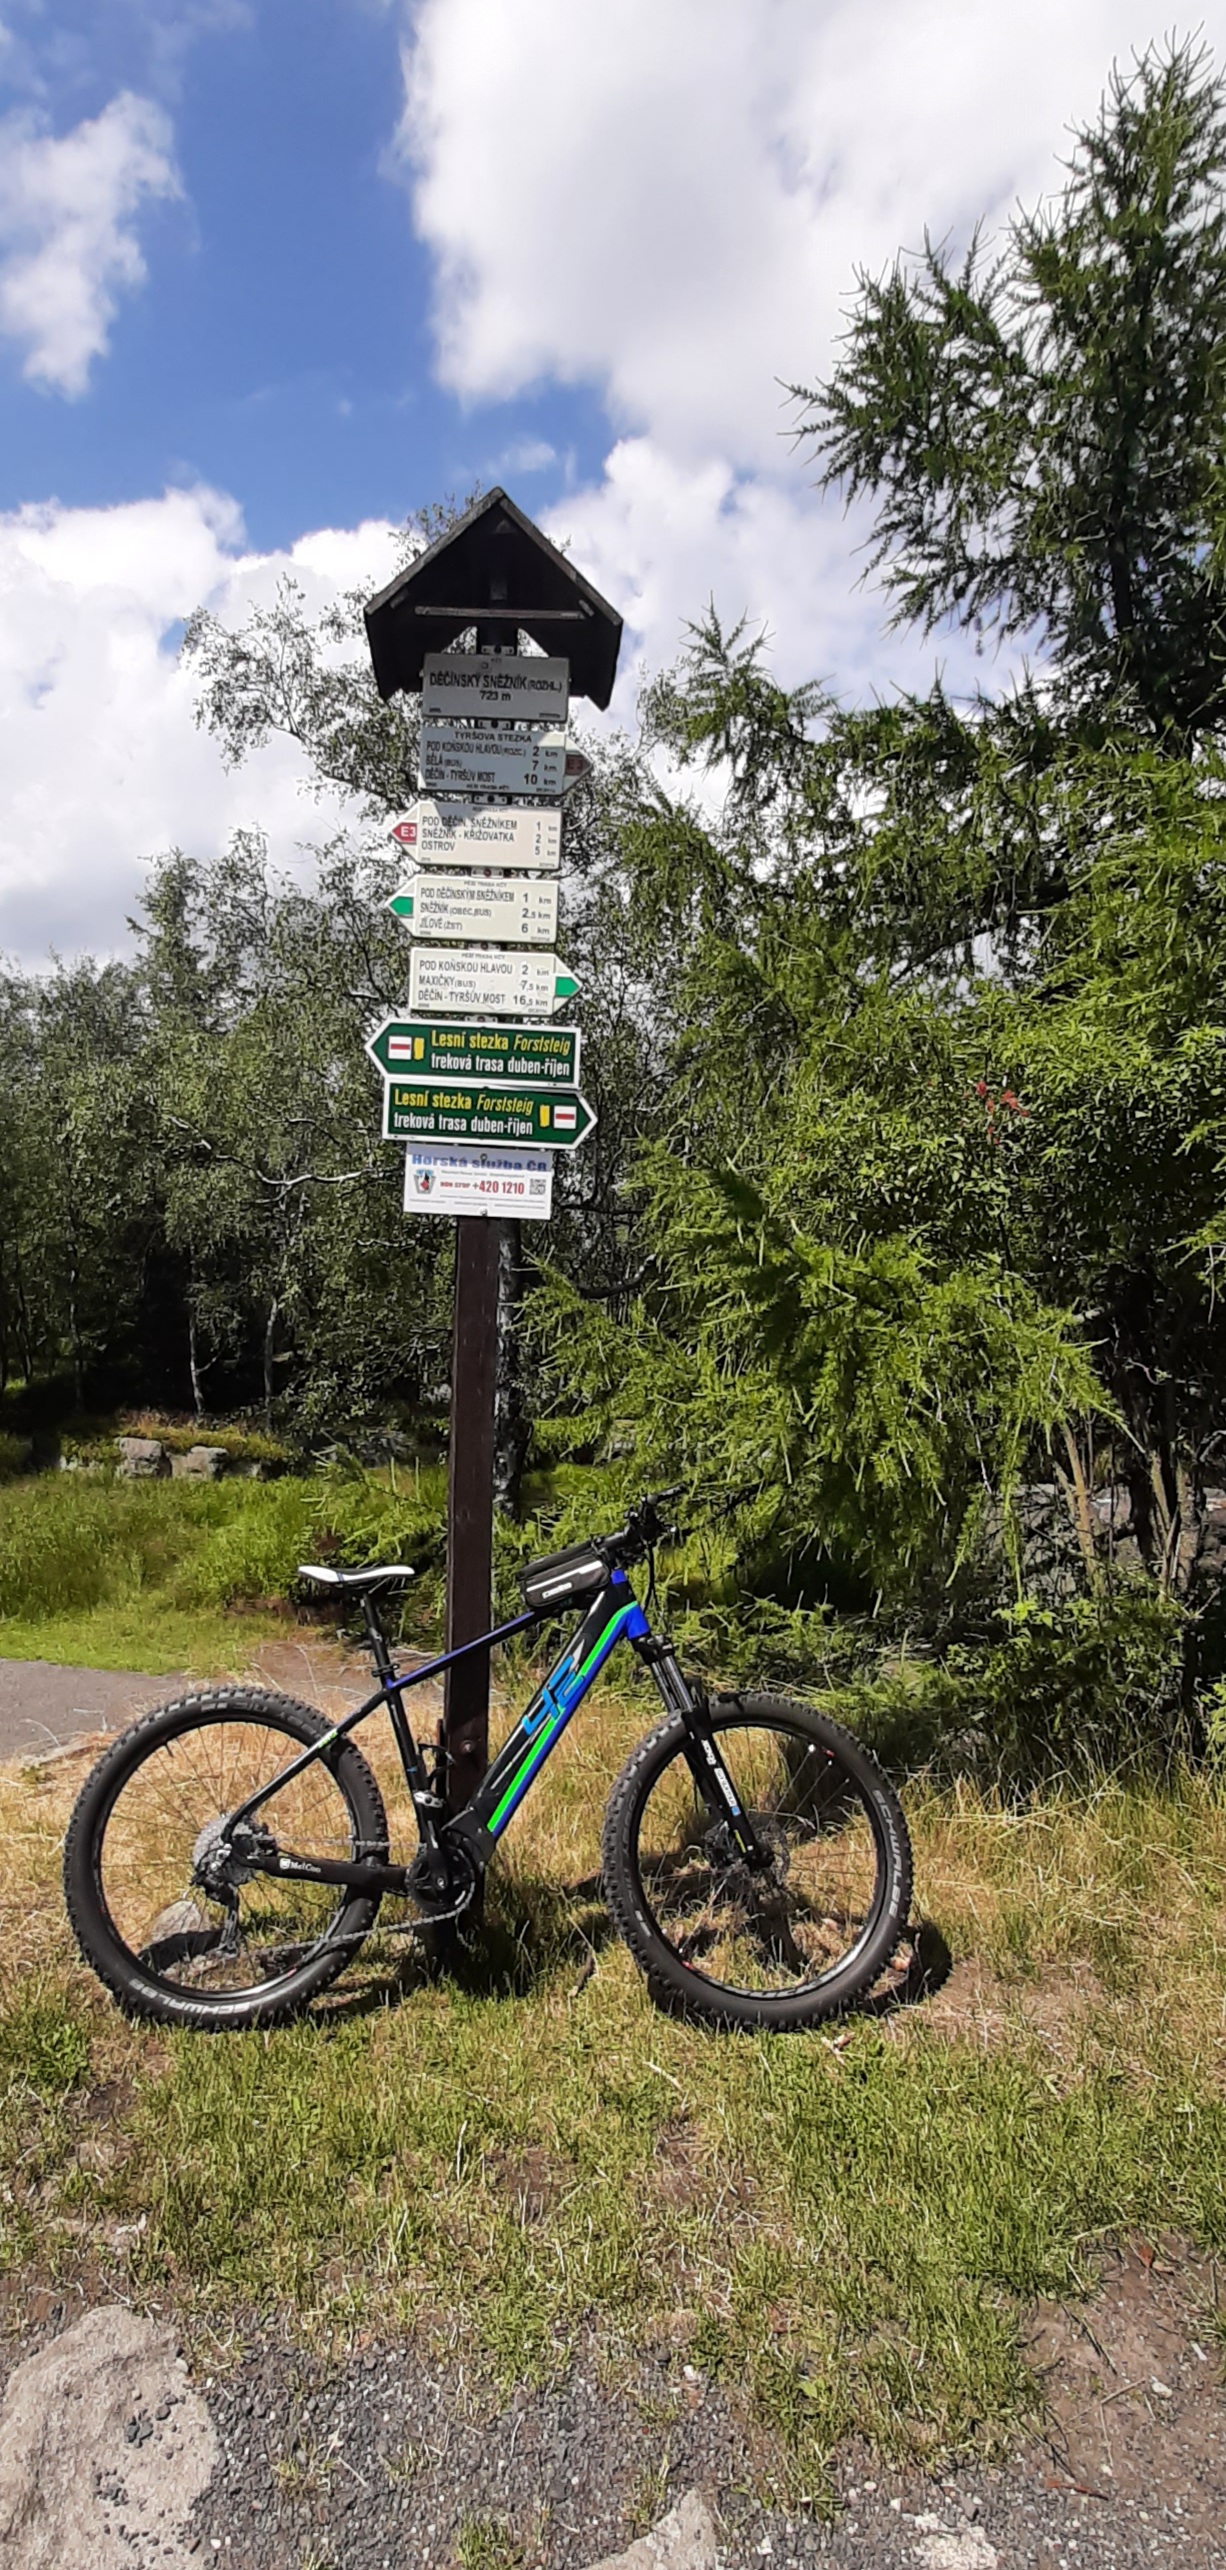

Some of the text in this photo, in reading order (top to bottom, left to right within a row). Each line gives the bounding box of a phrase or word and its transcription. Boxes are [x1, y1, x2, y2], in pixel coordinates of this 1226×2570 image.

[430, 672, 480, 687] DĚČÍNSKÝ
[483, 673, 527, 690] SNĚŽNÍK
[479, 690, 511, 701] 723 m
[455, 730, 532, 743] TYRŠOVA STEZKA
[427, 741, 440, 752] POD
[533, 745, 558, 758] 2 km
[532, 760, 557, 772] 7 km
[524, 773, 557, 786] 10 km
[422, 815, 439, 826] POD
[471, 816, 518, 830] SNĚŽNÍKEM
[536, 821, 541, 831] 1
[401, 826, 417, 838] E3
[422, 827, 457, 840] SNĚŽNÍK
[535, 833, 541, 844] 2
[421, 840, 456, 851] OSTROV
[535, 845, 541, 855] 5
[421, 887, 434, 898] POD
[523, 892, 552, 904] 1 km
[420, 901, 449, 914] SNĚŽNÍK
[538, 911, 551, 919] km
[521, 923, 550, 934] 6 km
[419, 958, 513, 974] POD KOŇSKOU HLAVOU
[522, 964, 549, 976] 2 km
[419, 974, 455, 987] MAXIČKY
[418, 988, 443, 1001] DĚČÍN
[483, 993, 506, 1005] MOST
[535, 999, 548, 1007] km
[431, 1029, 571, 1056] Lesní stezka Forststeig
[431, 1052, 570, 1078] treková trasa duben-říjen
[394, 1088, 534, 1115] Lesní stezka Forststeig
[394, 1112, 533, 1138] treková trasa duben-říjen
[412, 1153, 468, 1168] Horská
[472, 1156, 523, 1171] služba
[472, 1180, 499, 1193] +420
[502, 1181, 525, 1194] 1210
[872, 1789, 902, 1918] SCHWALBE
[129, 1979, 252, 2015] SCHWALBE
